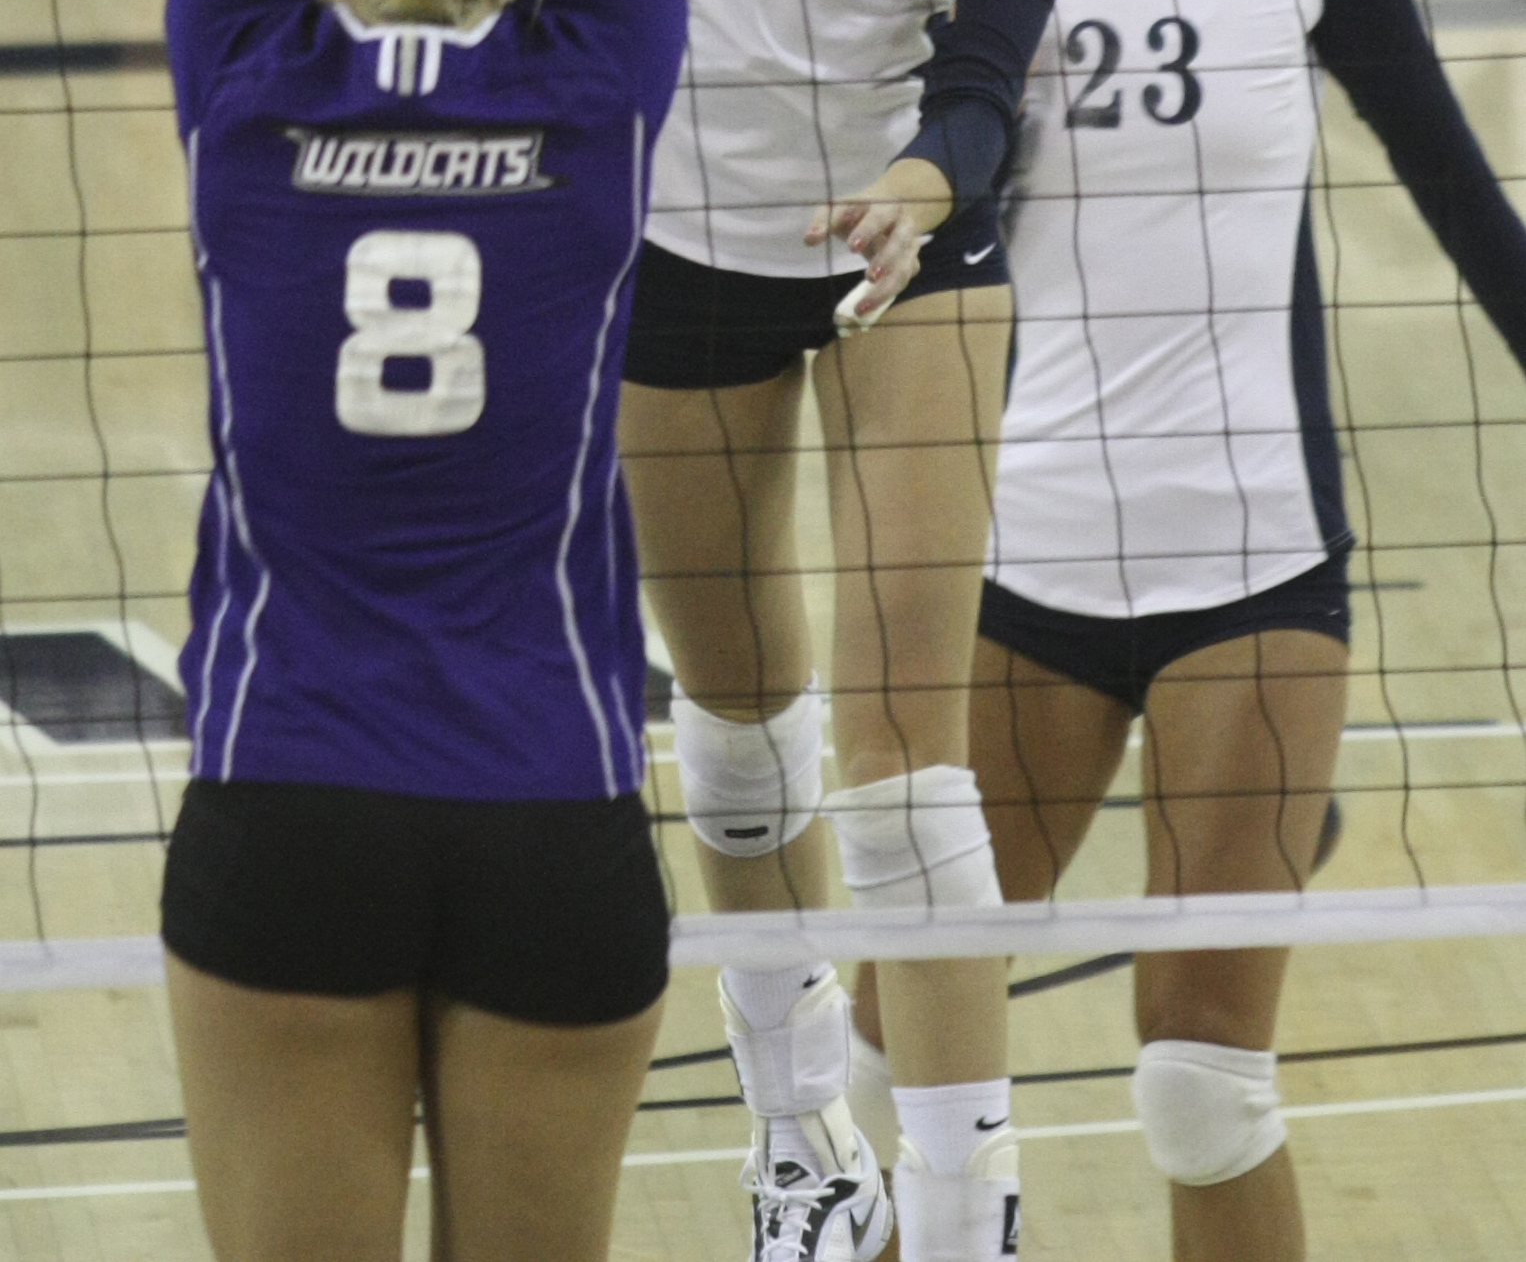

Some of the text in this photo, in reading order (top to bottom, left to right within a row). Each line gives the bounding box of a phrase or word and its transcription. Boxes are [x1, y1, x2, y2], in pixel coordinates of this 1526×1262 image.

[1064, 16, 1204, 128] 23
[301, 137, 534, 188] WILDCATS
[335, 229, 487, 437] 8
